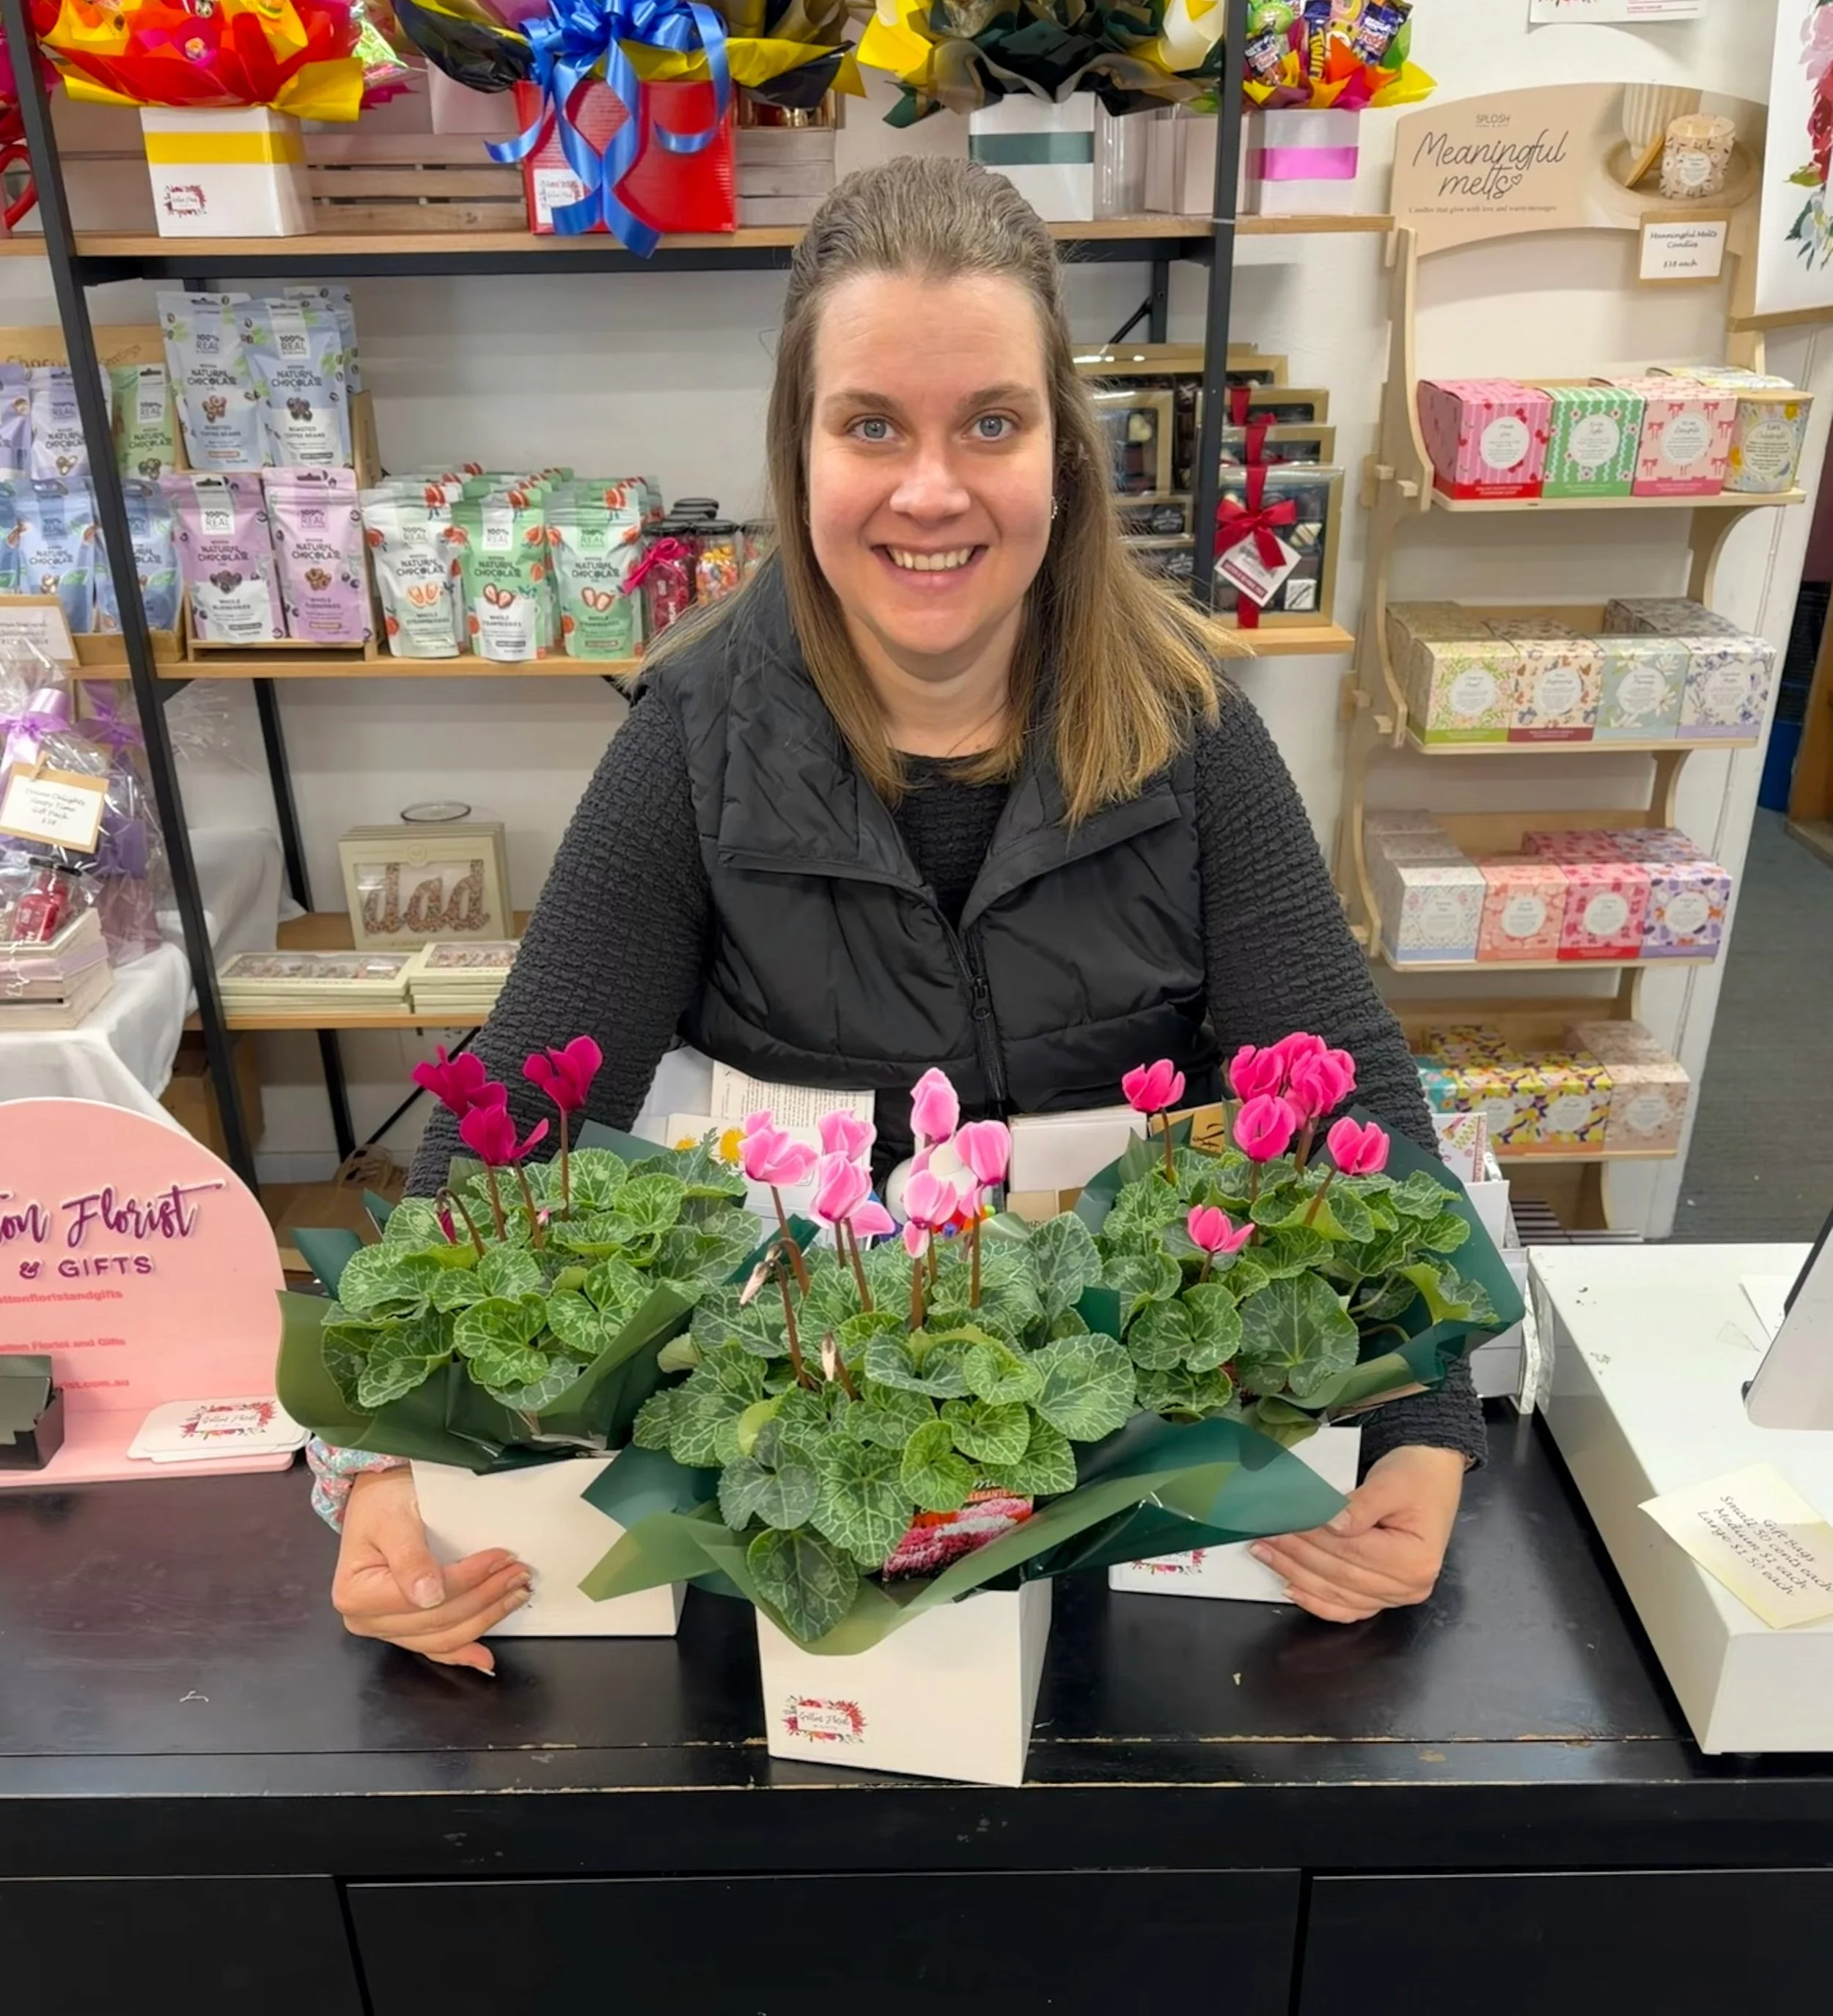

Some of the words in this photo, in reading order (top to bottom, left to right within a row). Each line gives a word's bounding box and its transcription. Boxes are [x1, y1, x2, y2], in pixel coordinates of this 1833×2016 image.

[1475, 114, 1510, 124] SPLOSH
[1412, 129, 1568, 170] Meaningful
[1438, 163, 1513, 200] melts
[1650, 230, 1696, 240] Meaningful
[1697, 229, 1717, 238] Melts
[1667, 240, 1698, 249] Candles
[1678, 259, 1698, 267] each
[45, 440, 87, 449] CHOCOLA
[133, 548, 153, 556] URAL
[362, 858, 491, 936] dad
[0, 1193, 48, 1244] on
[62, 1182, 224, 1248] Florist
[19, 1260, 41, 1280] &
[58, 1256, 153, 1278] GIFTS
[32, 1341, 70, 1350] Florist
[73, 1339, 95, 1347] and
[98, 1338, 126, 1346] Gifts
[1697, 1510, 1731, 1543] Large
[1762, 1571, 1796, 1596] each
[1713, 1507, 1760, 1550] Medium
[1776, 1565, 1808, 1590] each
[1720, 1496, 1758, 1528] Small
[1753, 1529, 1771, 1542] 50
[1800, 1569, 1833, 1592] each
[1763, 1519, 1789, 1539] Gift
[1785, 1539, 1816, 1563] Bags
